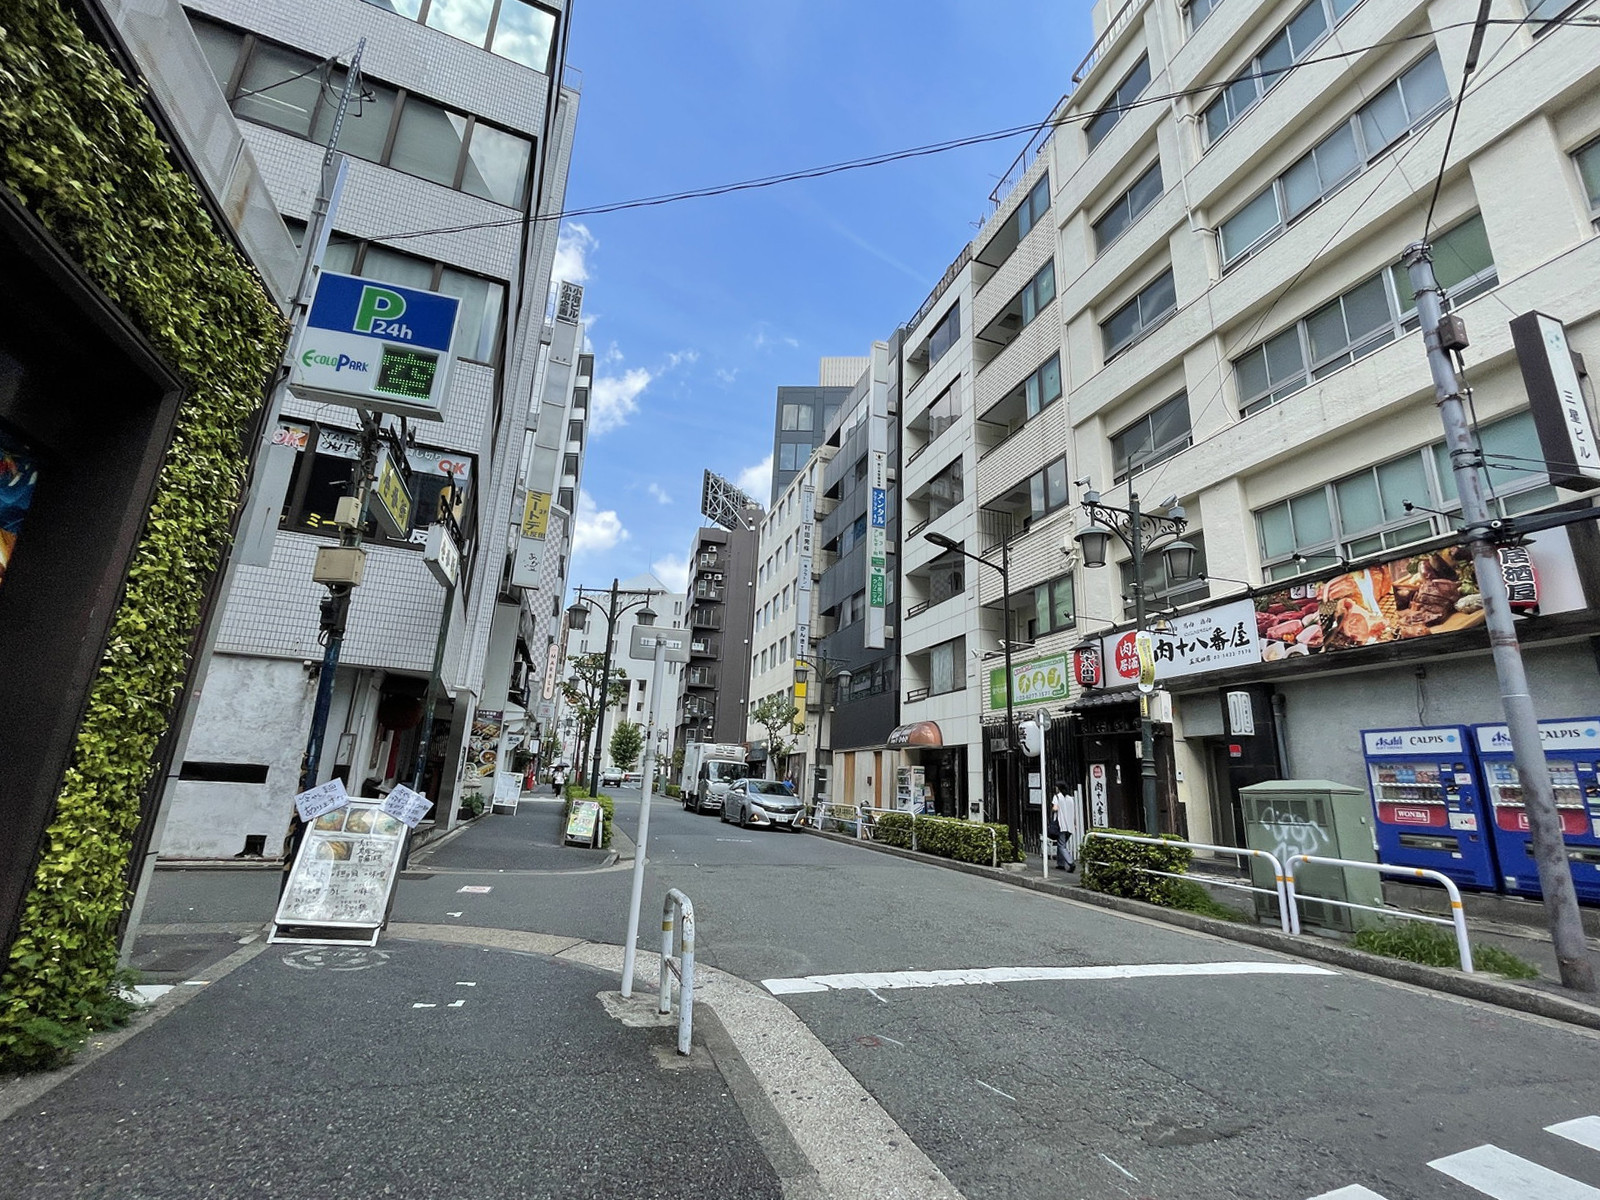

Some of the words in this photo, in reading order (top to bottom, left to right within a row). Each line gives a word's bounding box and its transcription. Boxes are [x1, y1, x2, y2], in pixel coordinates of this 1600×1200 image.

[353, 285, 406, 333] P
[569, 286, 582, 319] 小池ビル
[373, 320, 413, 340] 24h
[438, 460, 467, 475] OK
[877, 492, 885, 524] メンタル
[1497, 546, 1537, 602] 居酒屋
[1154, 622, 1250, 663] 肉十八番屋
[1120, 657, 1139, 672] 居酒
[1375, 736, 1403, 746] Asahi
[1410, 735, 1444, 746] CALPIS
[1397, 810, 1427, 819] WONDA
